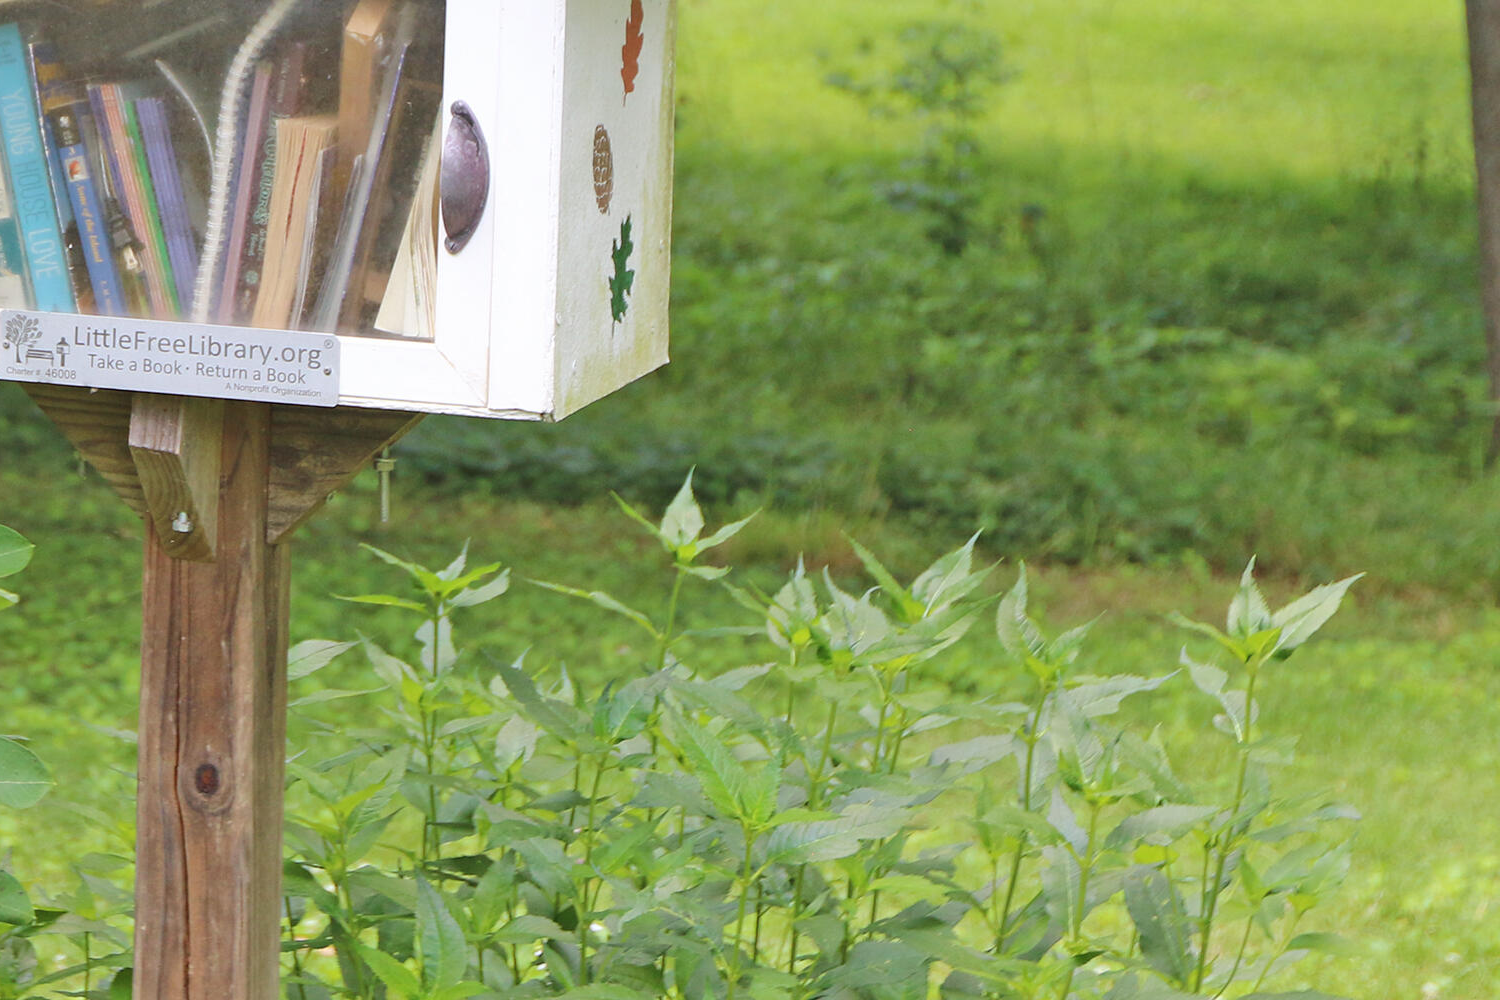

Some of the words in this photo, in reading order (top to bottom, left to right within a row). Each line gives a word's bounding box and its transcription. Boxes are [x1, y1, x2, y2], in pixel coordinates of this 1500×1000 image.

[1, 89, 34, 155] YOUNG
[14, 160, 49, 225] HOUSE
[27, 227, 62, 279] LOVE
[74, 325, 322, 369] LittleFreeLibrary.org
[87, 353, 125, 371] Take
[128, 360, 138, 371] a
[143, 358, 182, 375] Book
[196, 362, 248, 380] Return
[252, 369, 262, 381] a
[267, 367, 307, 385] Book
[6, 366, 34, 376] Charter
[44, 368, 77, 380] 46008
[225, 382, 232, 390] A
[233, 383, 270, 394] Nonprofit
[270, 385, 322, 398] Organization
